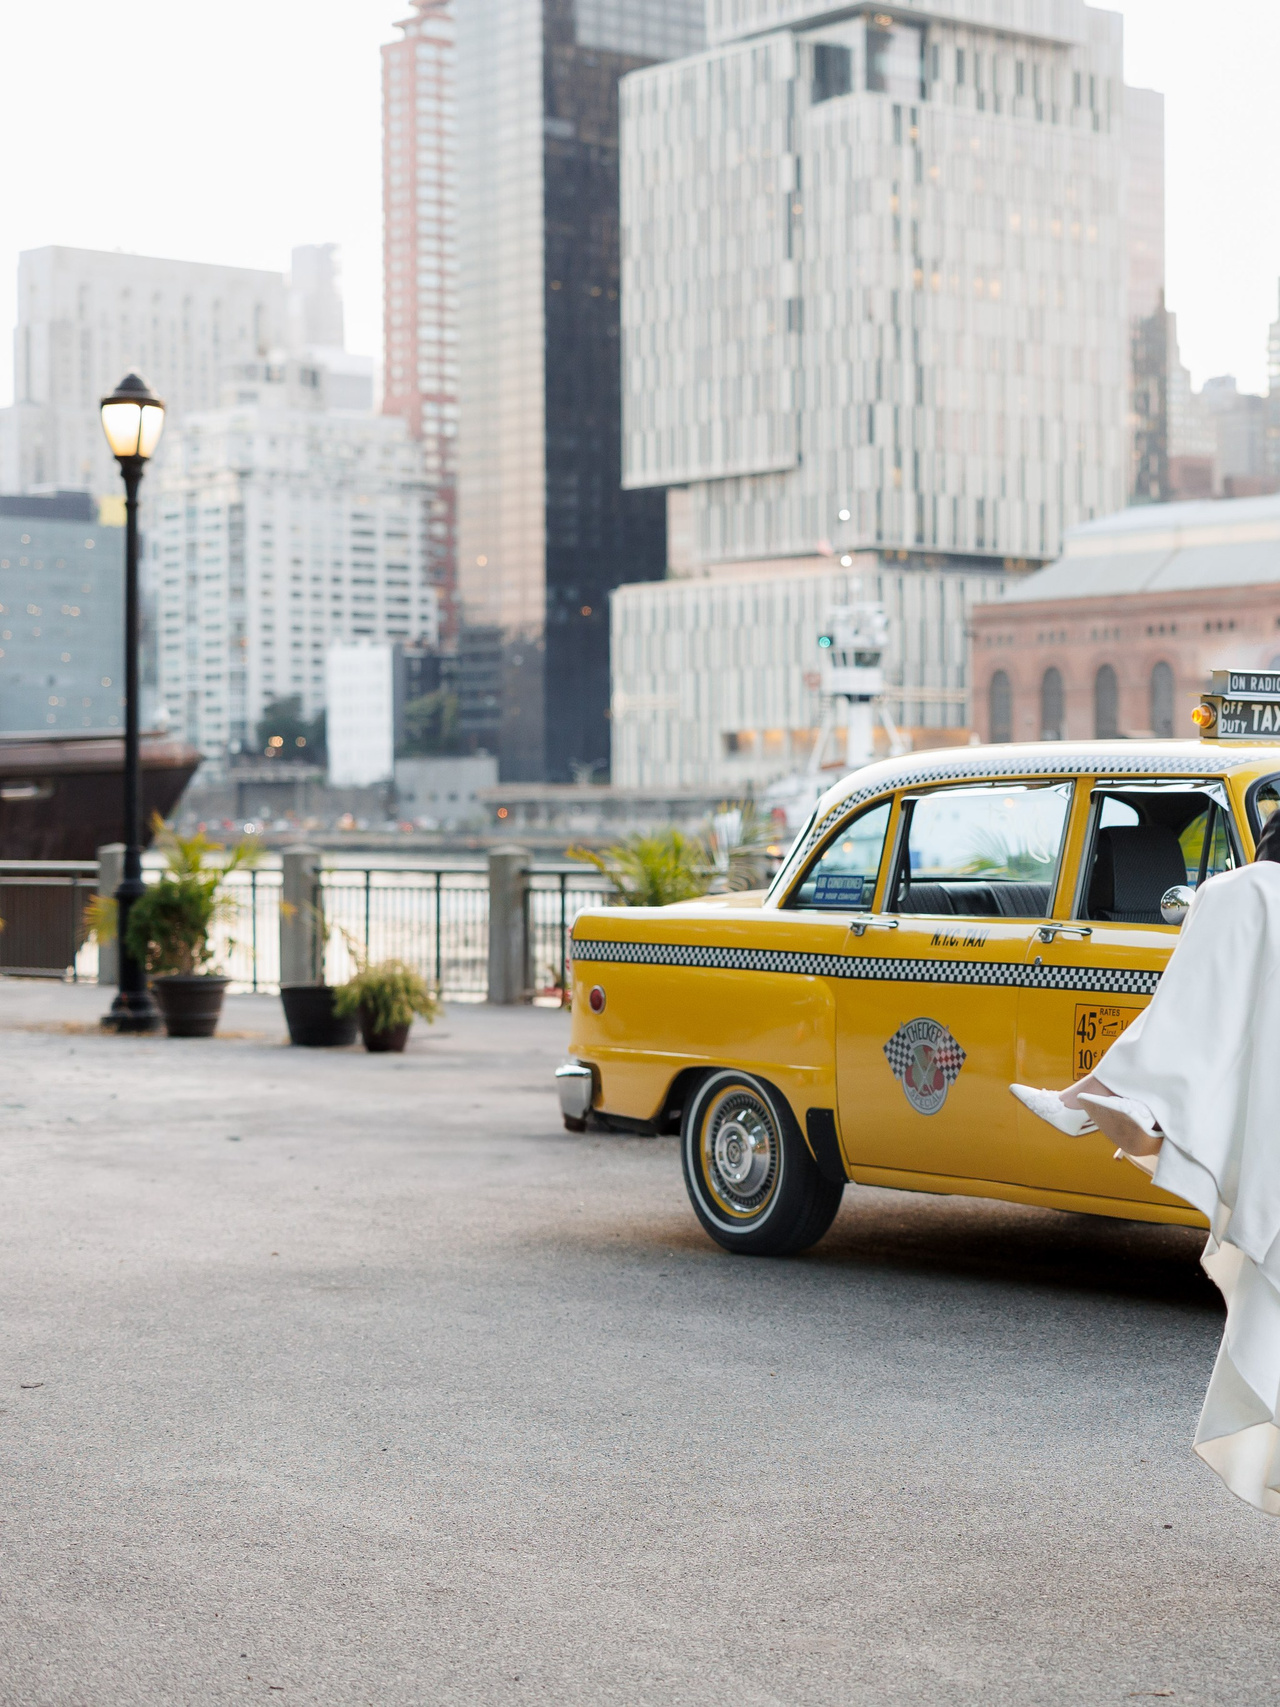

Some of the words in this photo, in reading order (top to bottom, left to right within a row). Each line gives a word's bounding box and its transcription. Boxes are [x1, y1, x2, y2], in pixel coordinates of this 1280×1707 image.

[1232, 675, 1246, 690] ON
[1222, 702, 1243, 715] OFF
[1221, 719, 1247, 734] DUTY
[930, 928, 960, 947] N.Y.C.
[962, 929, 990, 948] TAXI
[1100, 1008, 1120, 1017] RATES
[906, 1022, 942, 1043] CHECKER
